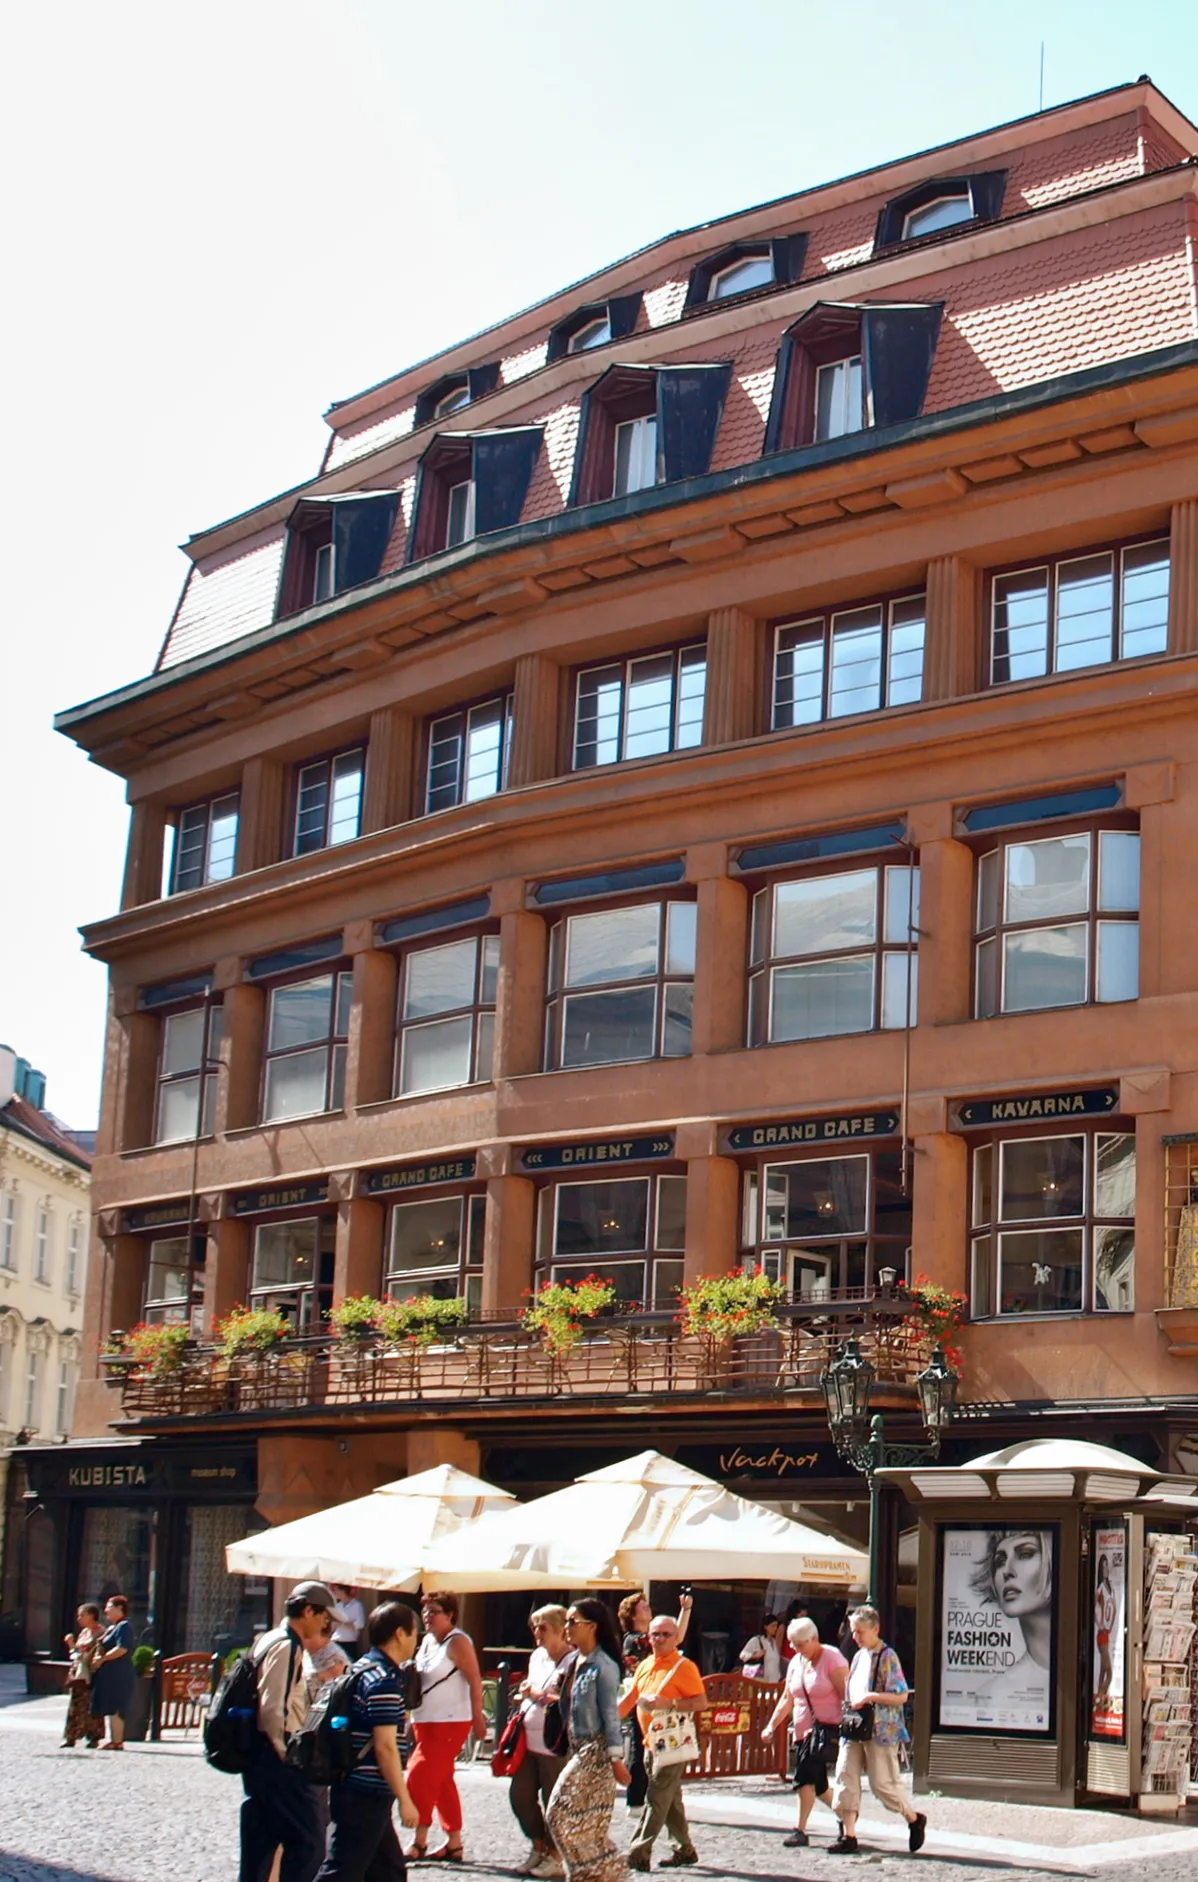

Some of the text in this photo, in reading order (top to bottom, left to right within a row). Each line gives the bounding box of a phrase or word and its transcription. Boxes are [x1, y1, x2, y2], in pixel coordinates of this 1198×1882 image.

[992, 1096, 1085, 1119] KAVARNA
[752, 1118, 875, 1144] GRAND CAFE
[562, 1143, 633, 1163] ORIENT
[382, 1163, 464, 1188] GRAND CAFE
[259, 1188, 307, 1207] ORIENT
[69, 1466, 147, 1486] KUBISTA
[948, 1611, 1002, 1628] PRAGUE
[947, 1631, 1011, 1647] FASHION
[947, 1649, 1015, 1667] WEEKEND
